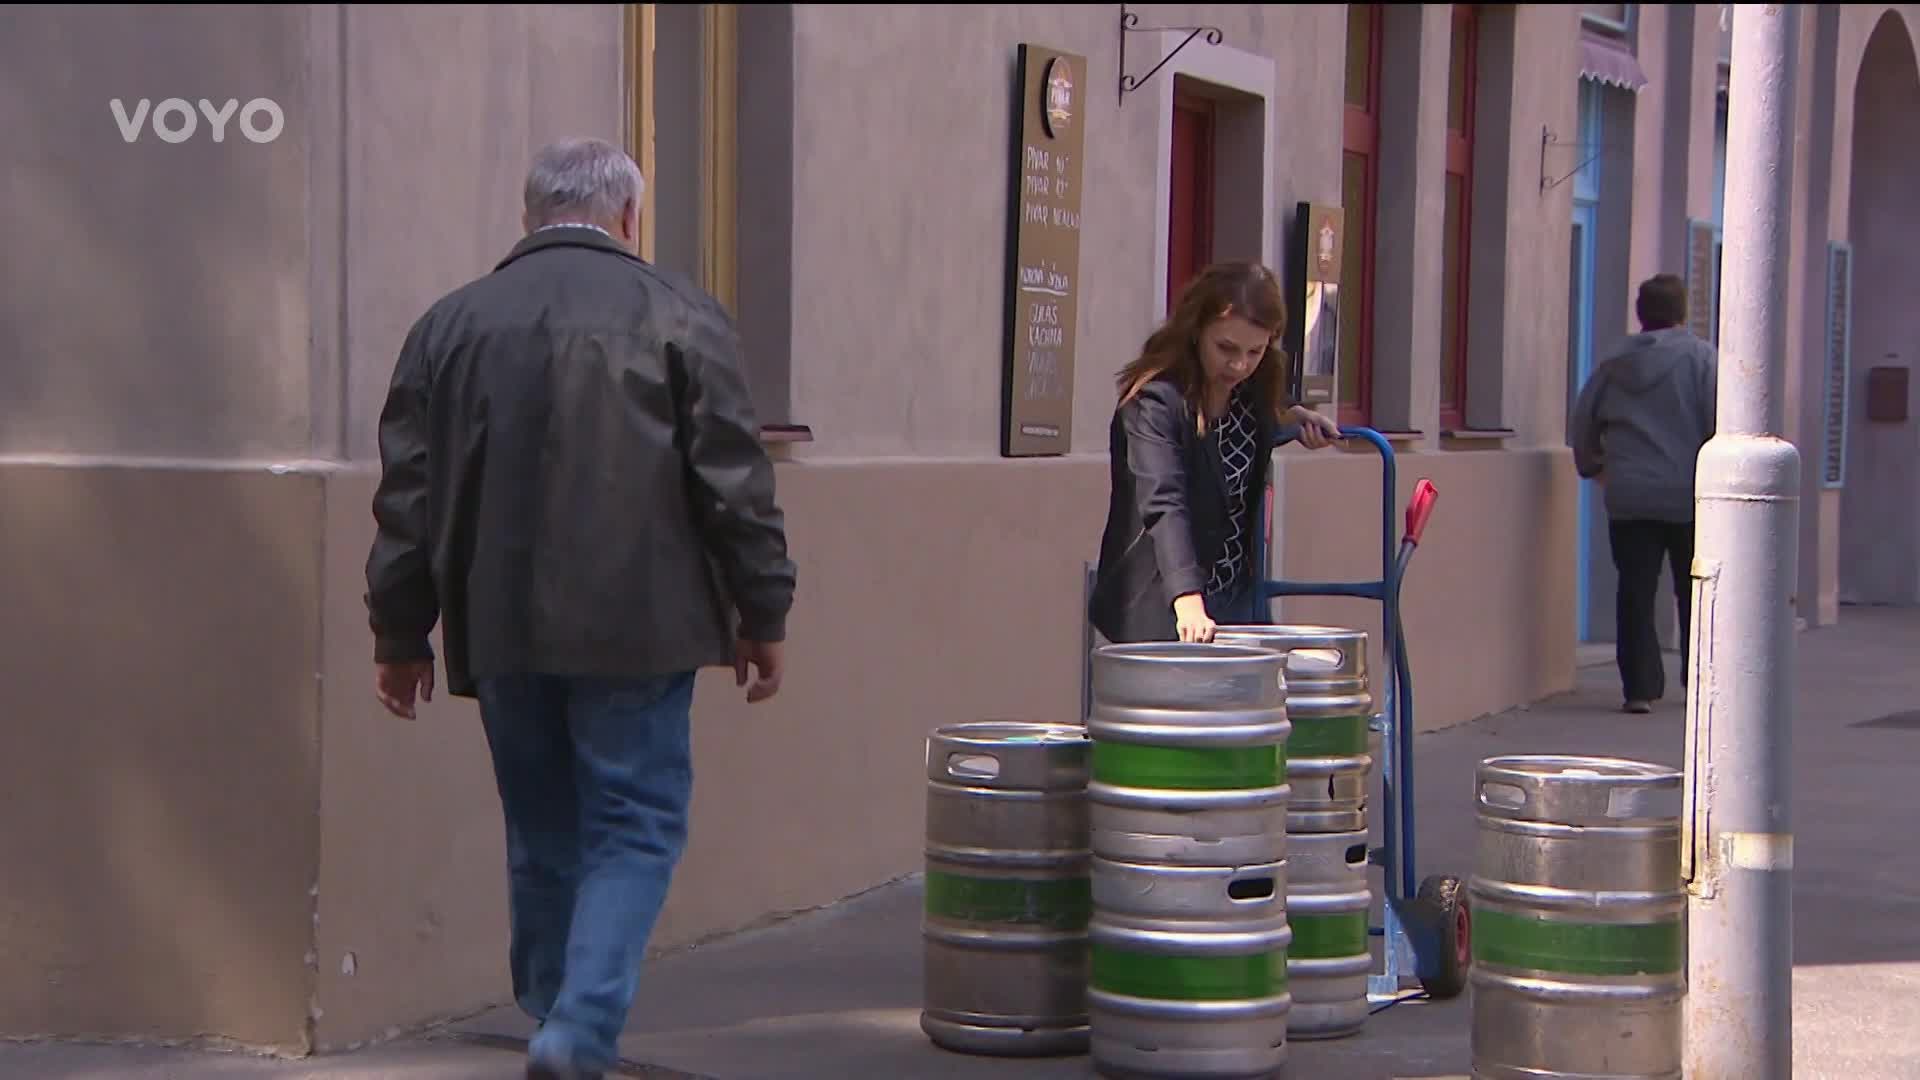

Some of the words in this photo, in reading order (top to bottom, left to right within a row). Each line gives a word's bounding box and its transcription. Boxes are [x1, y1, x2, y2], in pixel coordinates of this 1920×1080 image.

[1027, 146, 1049, 171] PIVAR
[1026, 175, 1049, 196] PIVAR
[1025, 202, 1048, 227] PIVAR
